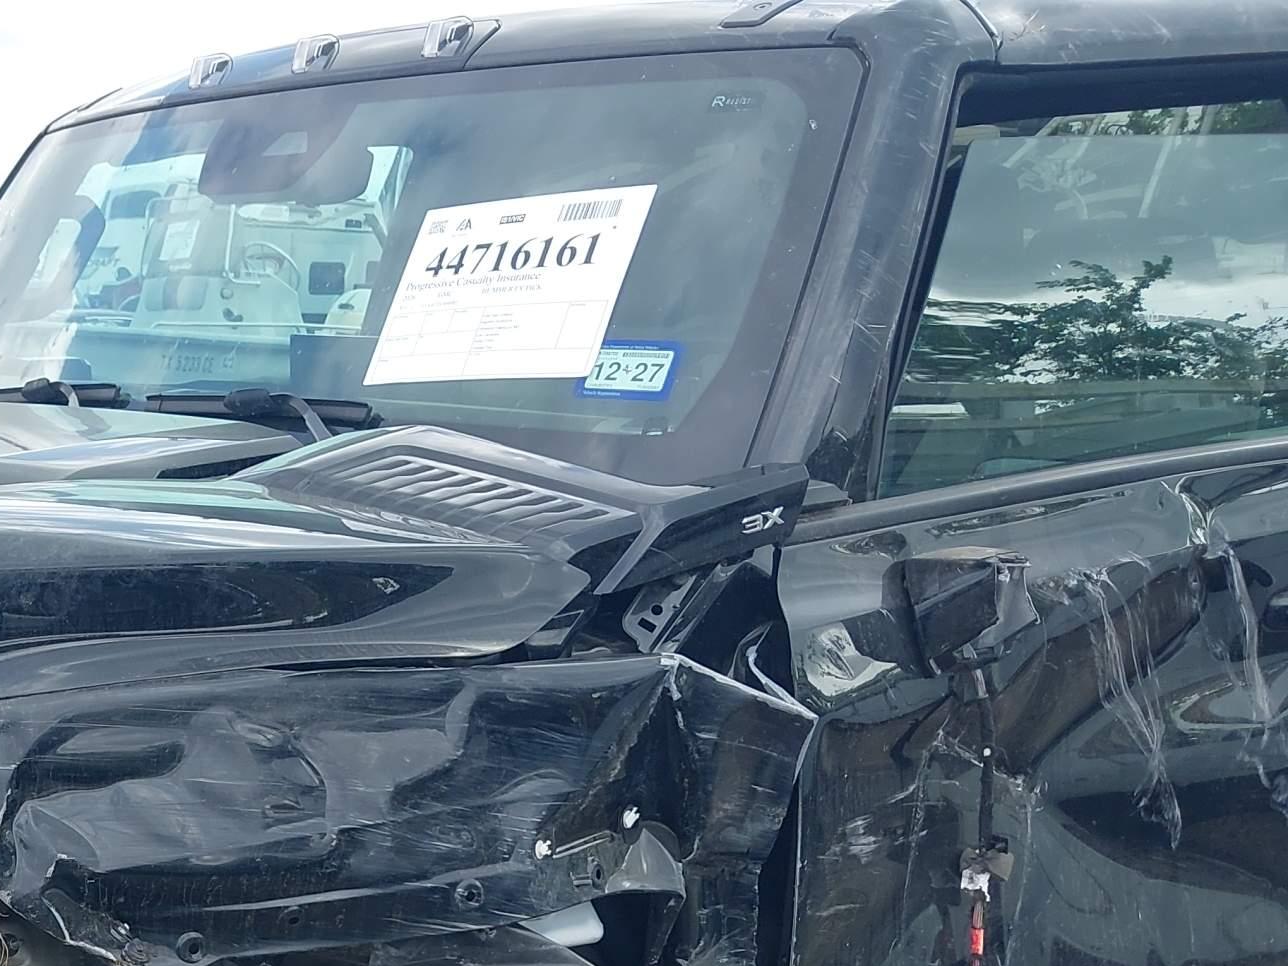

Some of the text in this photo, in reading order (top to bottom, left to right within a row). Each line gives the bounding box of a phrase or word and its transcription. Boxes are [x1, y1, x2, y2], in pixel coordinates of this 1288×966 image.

[424, 232, 602, 278] 44716161
[405, 272, 543, 292] Progressive Casualty Insurance
[630, 362, 665, 383] 27
[741, 506, 785, 535] 3X
